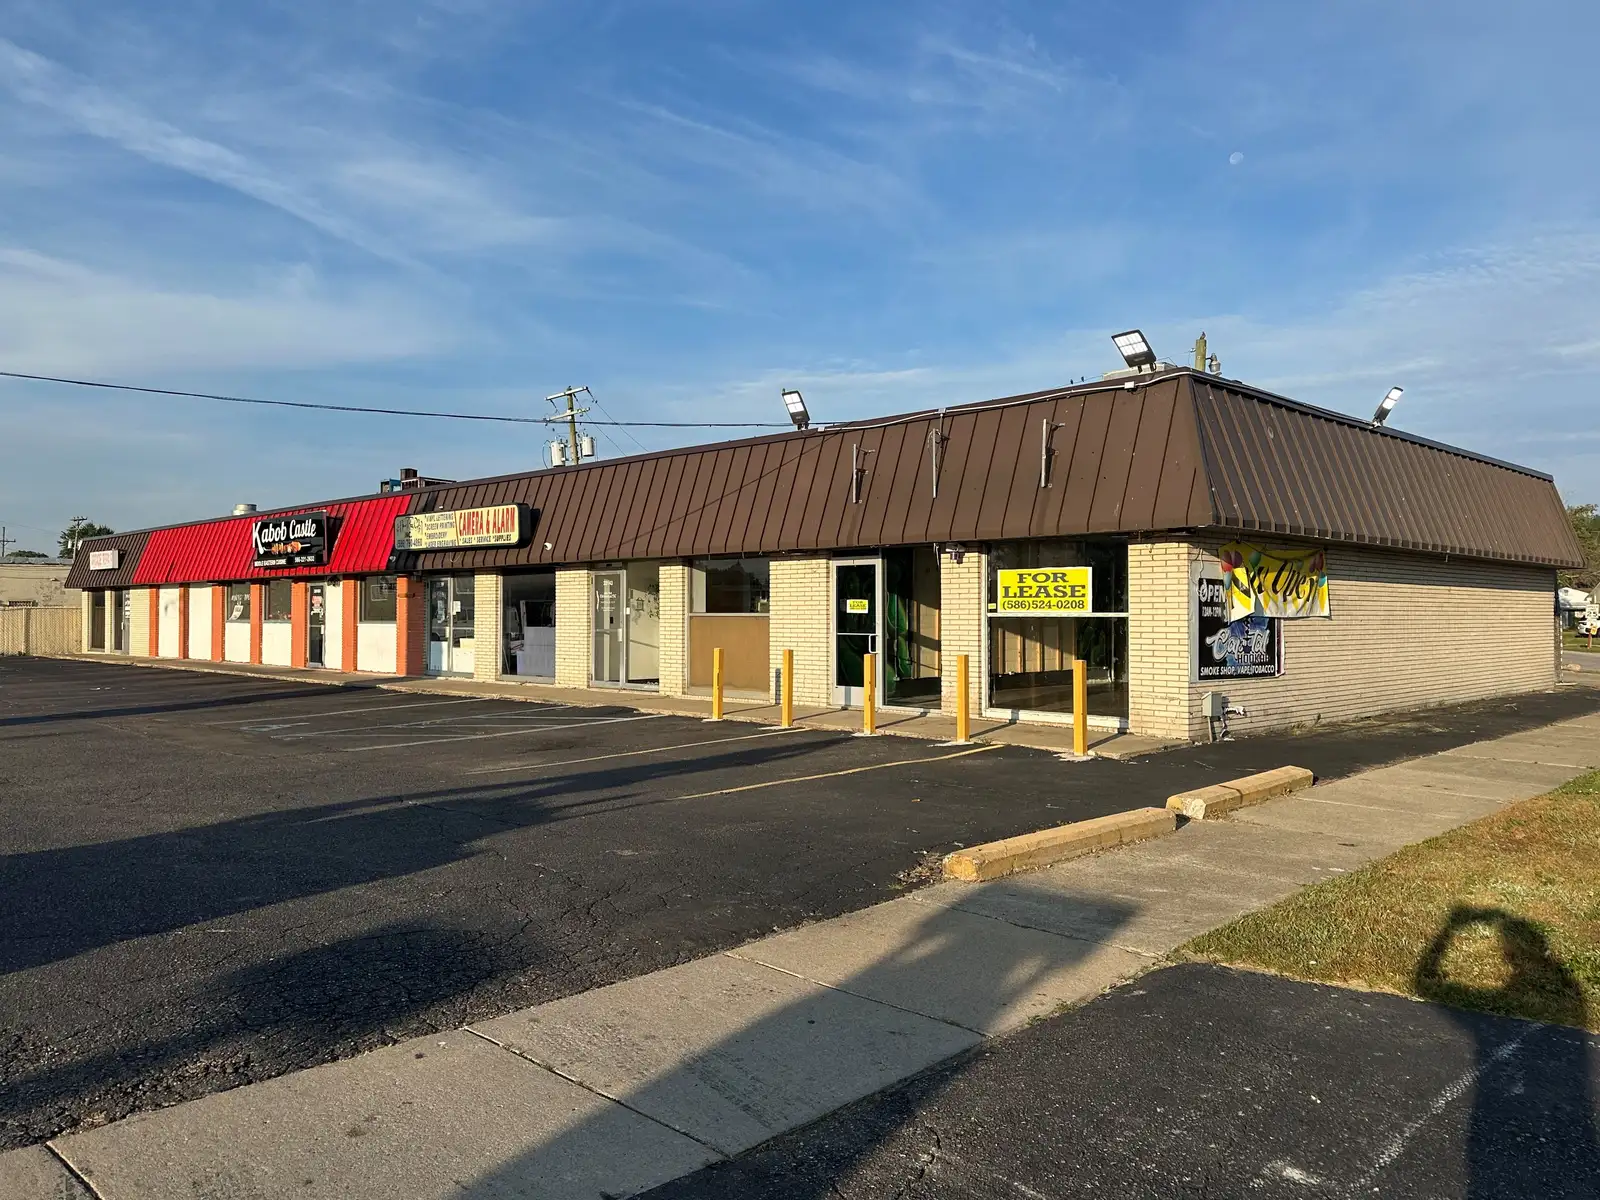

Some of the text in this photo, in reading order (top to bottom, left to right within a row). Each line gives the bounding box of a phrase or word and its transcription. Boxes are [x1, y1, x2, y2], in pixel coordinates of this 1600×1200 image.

[459, 507, 516, 537] CAMERA & ALARM
[252, 519, 317, 555] Kabob Castle
[1017, 572, 1069, 583] FOR
[1271, 560, 1316, 603] Open
[1002, 585, 1086, 598] LEASE
[1199, 584, 1226, 603] OPEN
[1002, 600, 1085, 611] (586)524-0208
[1200, 665, 1220, 676] SMOKE
